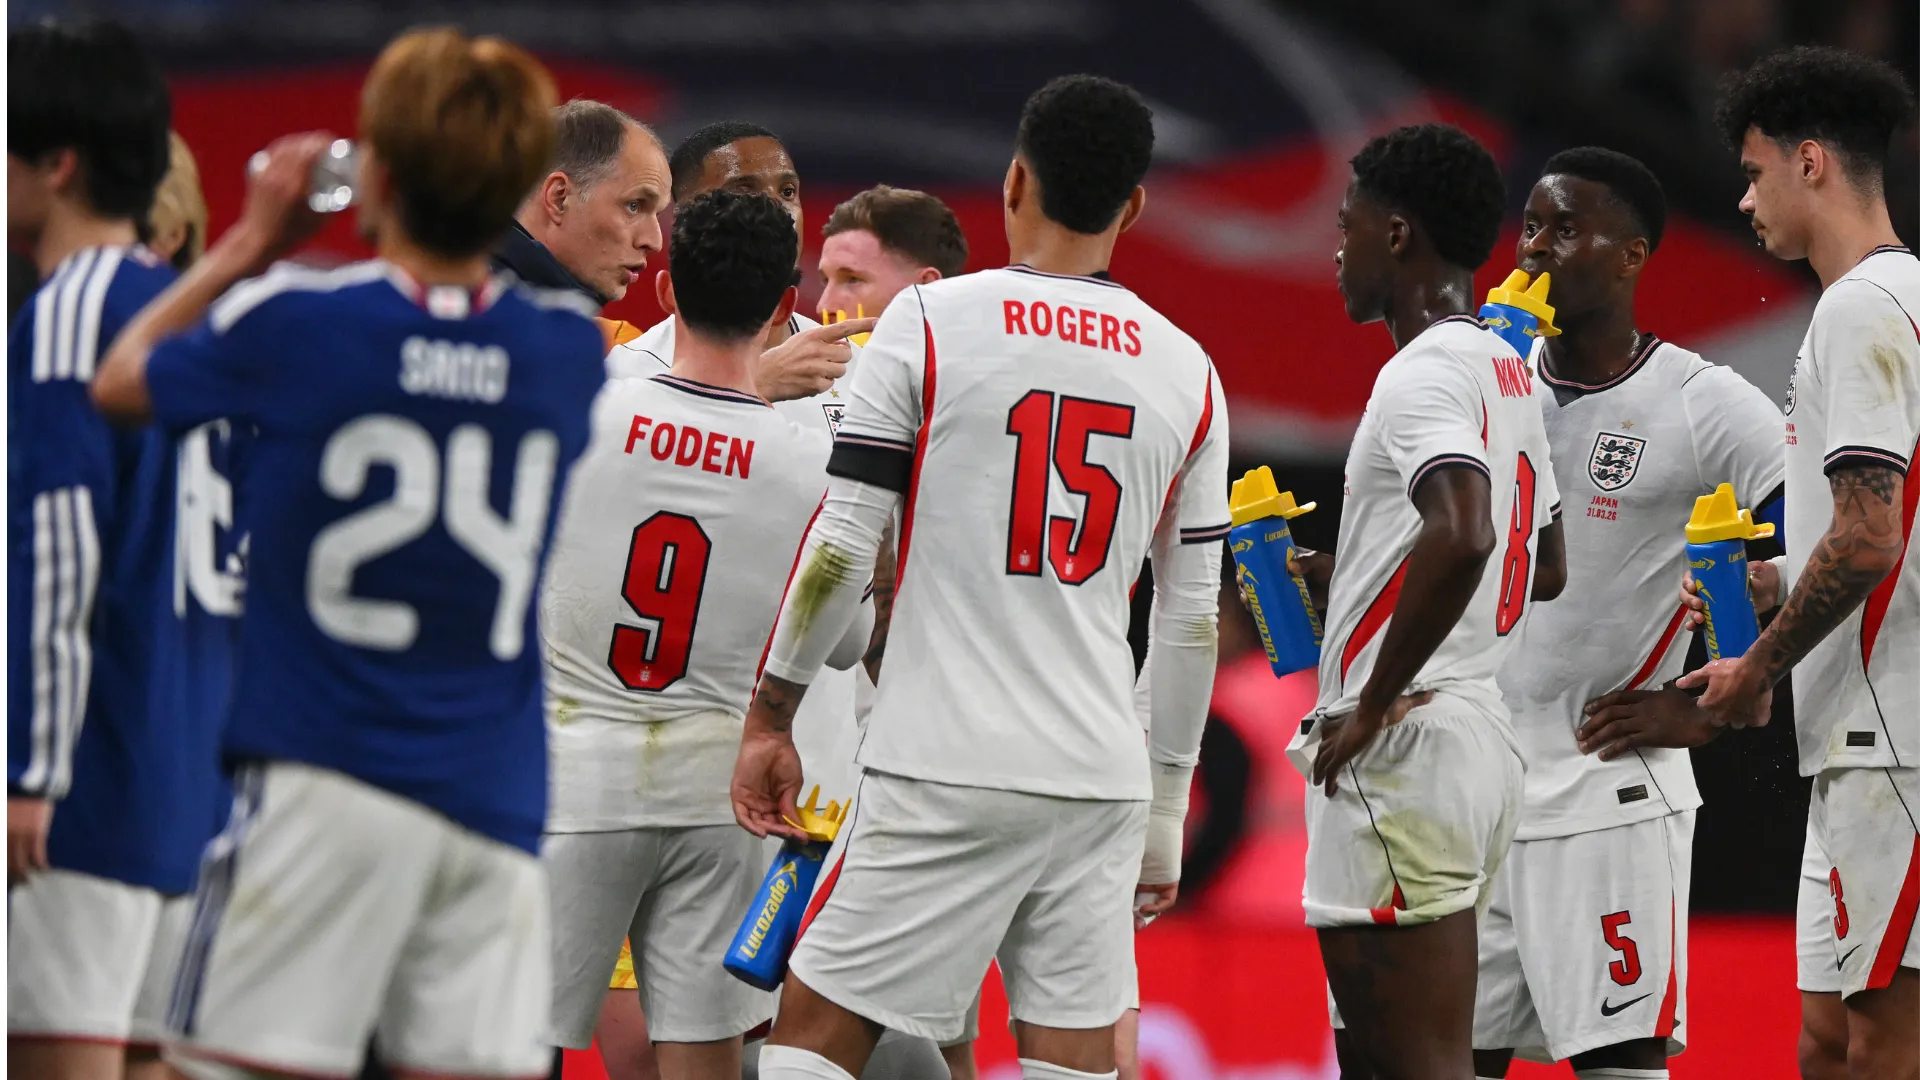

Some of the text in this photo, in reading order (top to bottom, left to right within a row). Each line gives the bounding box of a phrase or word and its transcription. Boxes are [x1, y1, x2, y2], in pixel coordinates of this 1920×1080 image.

[1003, 300, 1142, 357] ROGERS
[624, 415, 755, 480] FODEN
[1005, 389, 1135, 586] 15
[1587, 507, 1617, 520] 31.03.26
[1591, 495, 1618, 508] JAPAN
[308, 414, 559, 661] 24
[1496, 451, 1536, 637] 8
[608, 510, 712, 692] 9
[739, 878, 790, 959] Lucozade
[1829, 866, 1849, 941] 3
[1600, 910, 1642, 986] 5
